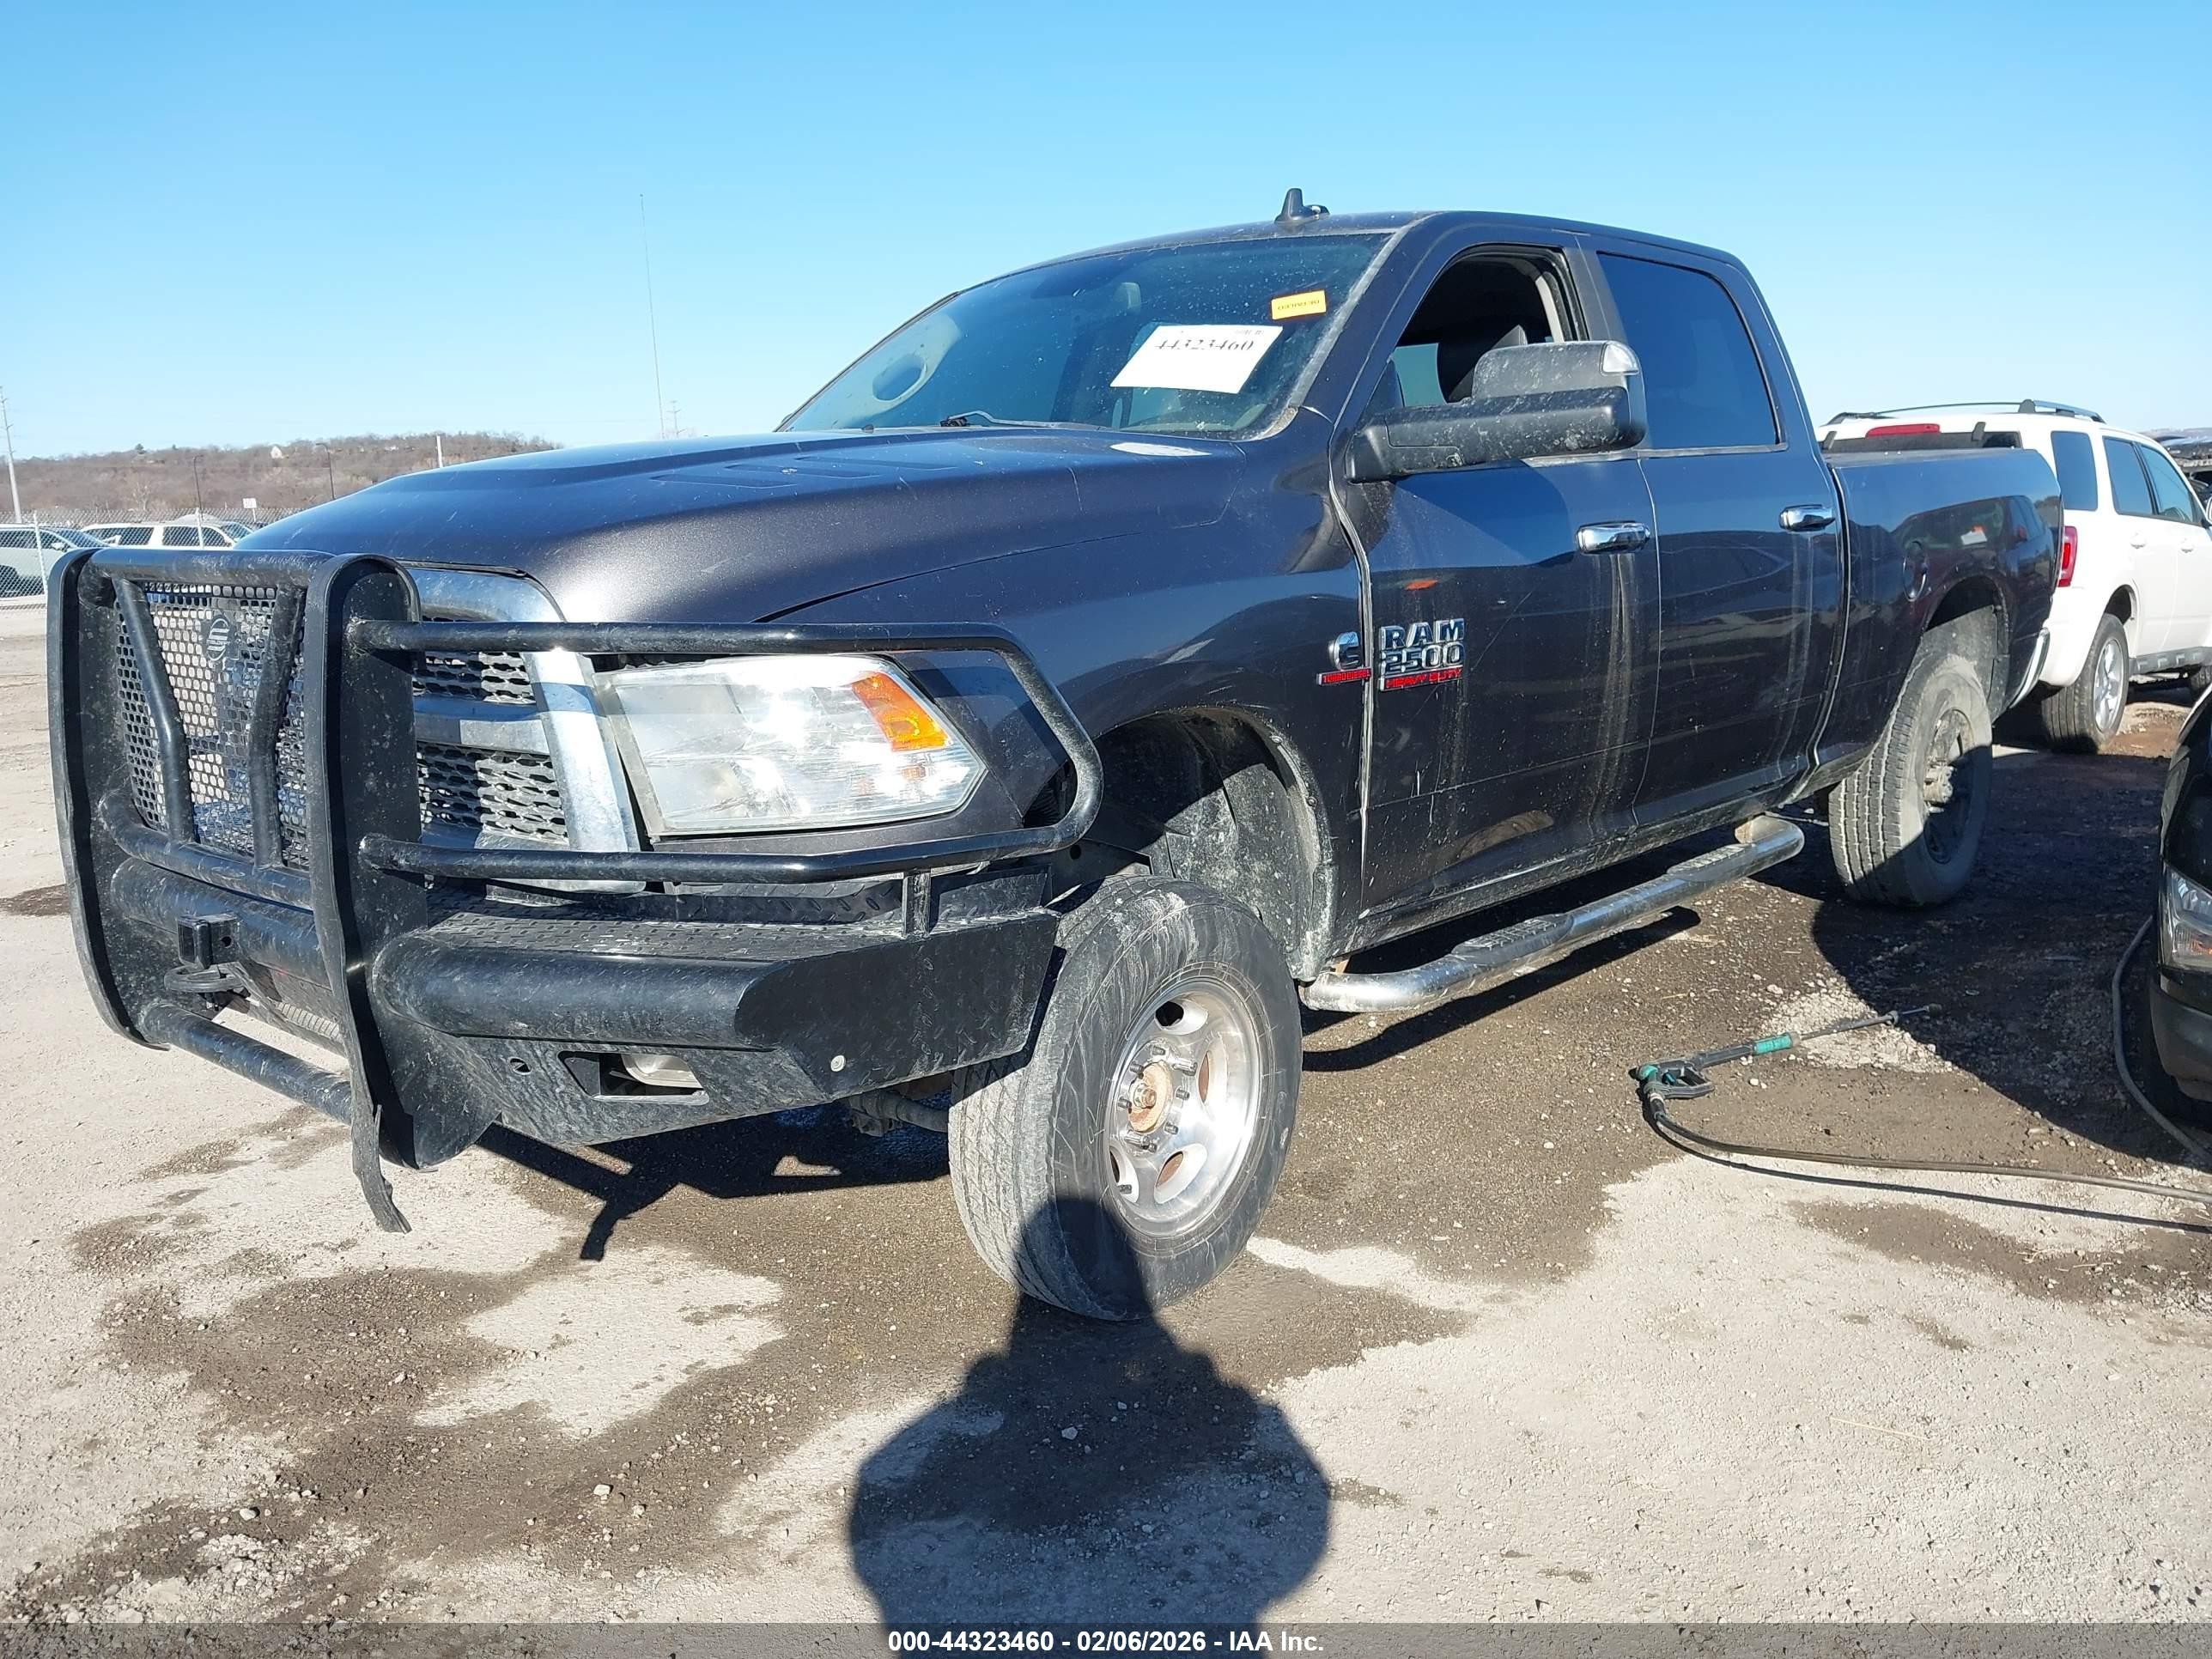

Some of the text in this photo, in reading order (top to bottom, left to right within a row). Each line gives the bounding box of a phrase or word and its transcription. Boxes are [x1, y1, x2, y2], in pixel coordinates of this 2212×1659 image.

[1154, 338, 1255, 350] 44323460
[1379, 618, 1464, 650] RAM
[1380, 641, 1465, 674] 2500
[1385, 667, 1462, 689] HEAVY DUTY
